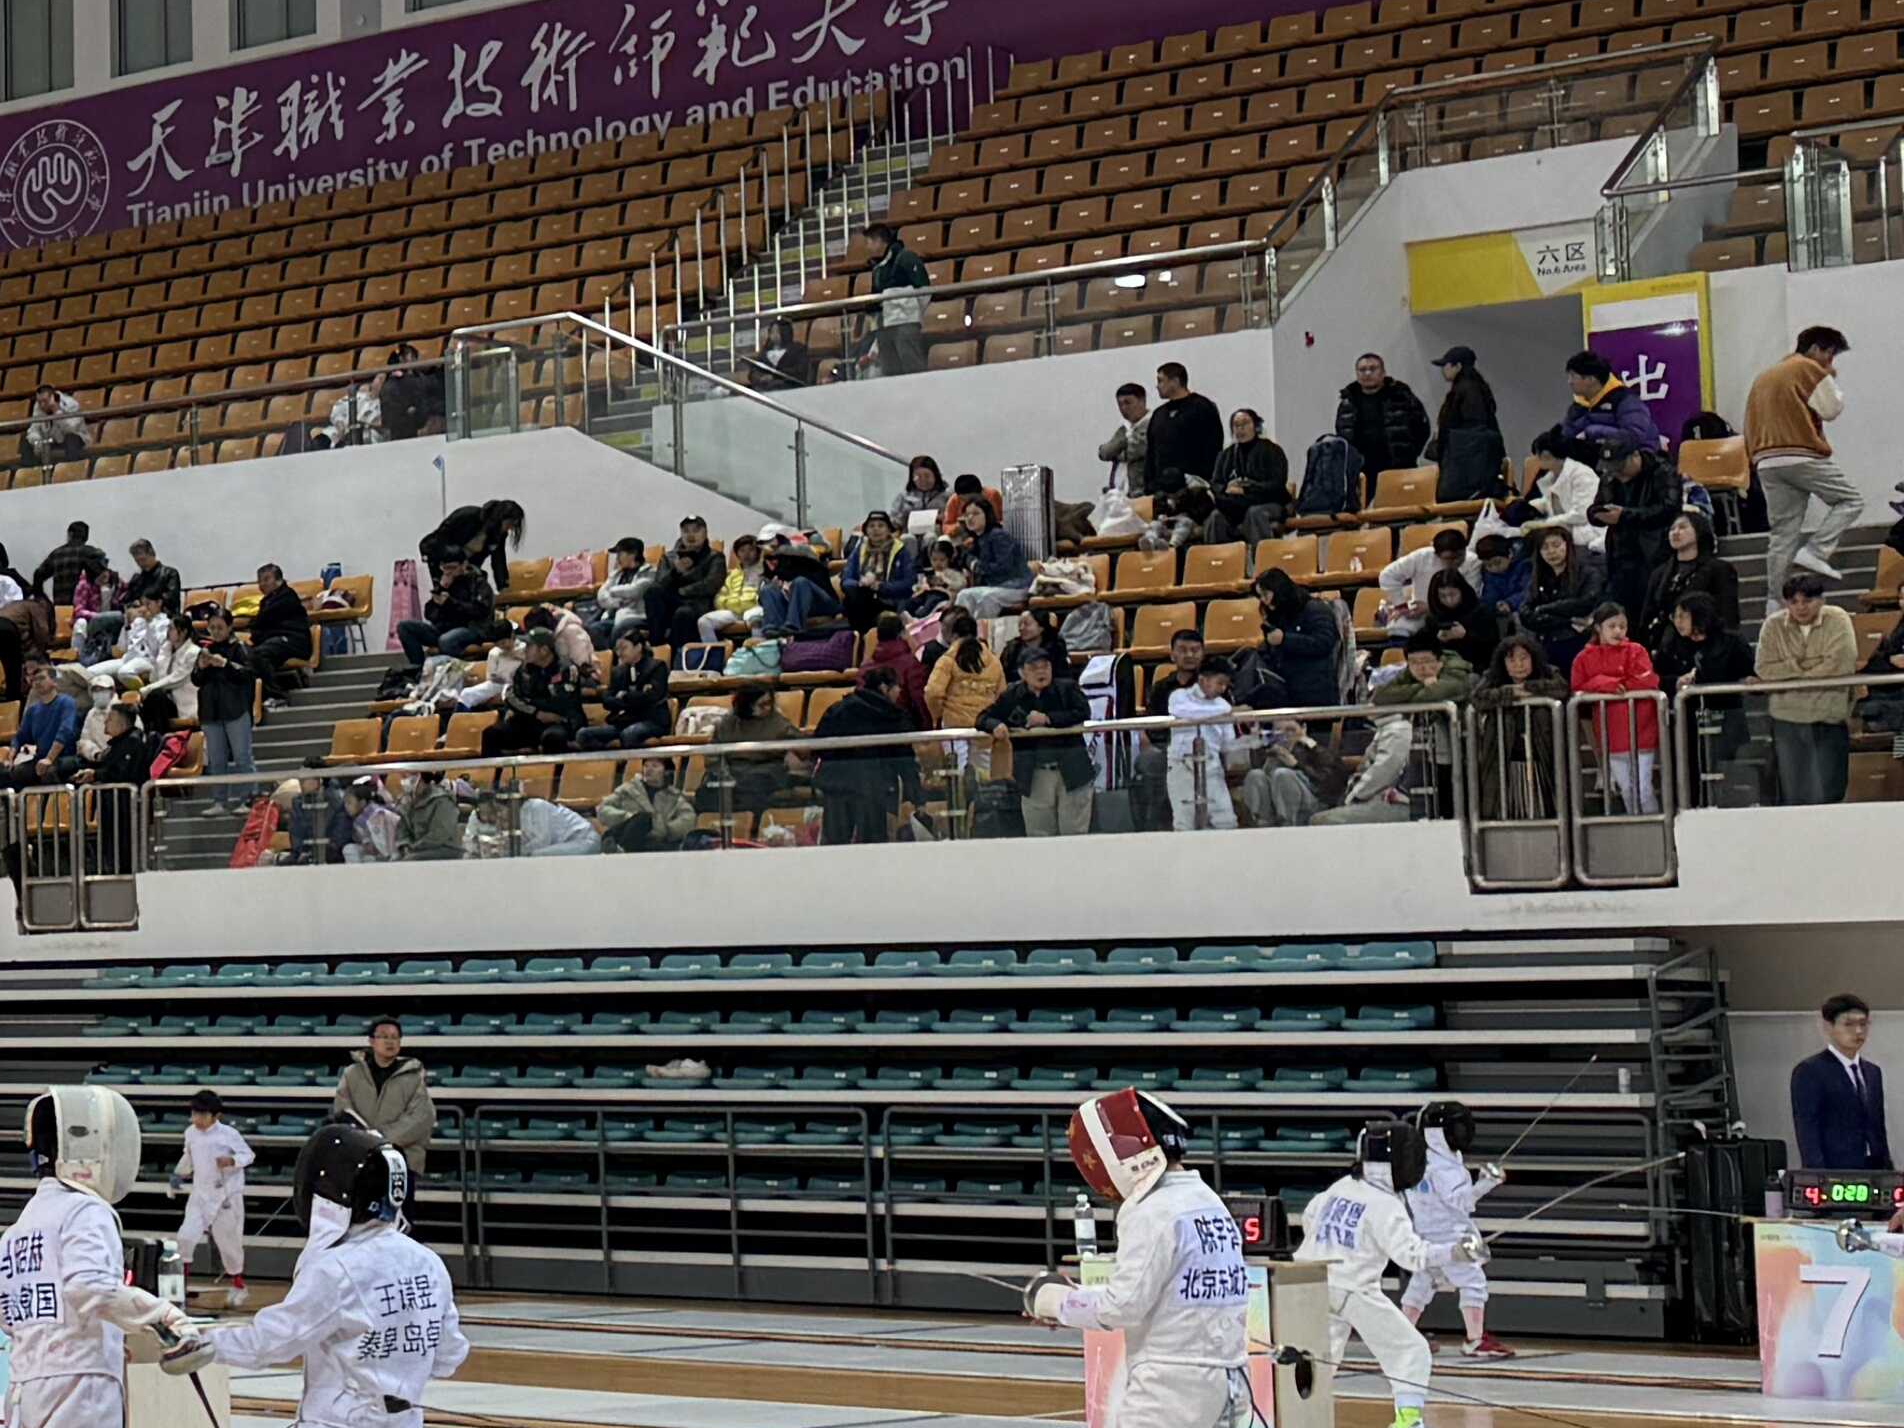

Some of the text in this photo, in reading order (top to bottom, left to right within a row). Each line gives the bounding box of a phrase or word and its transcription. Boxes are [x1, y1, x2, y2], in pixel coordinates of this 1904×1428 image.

[126, 55, 966, 228] Tianjin University of Technology and Education
[1537, 241, 1585, 265] 六区
[1799, 1265, 1871, 1359] 7
